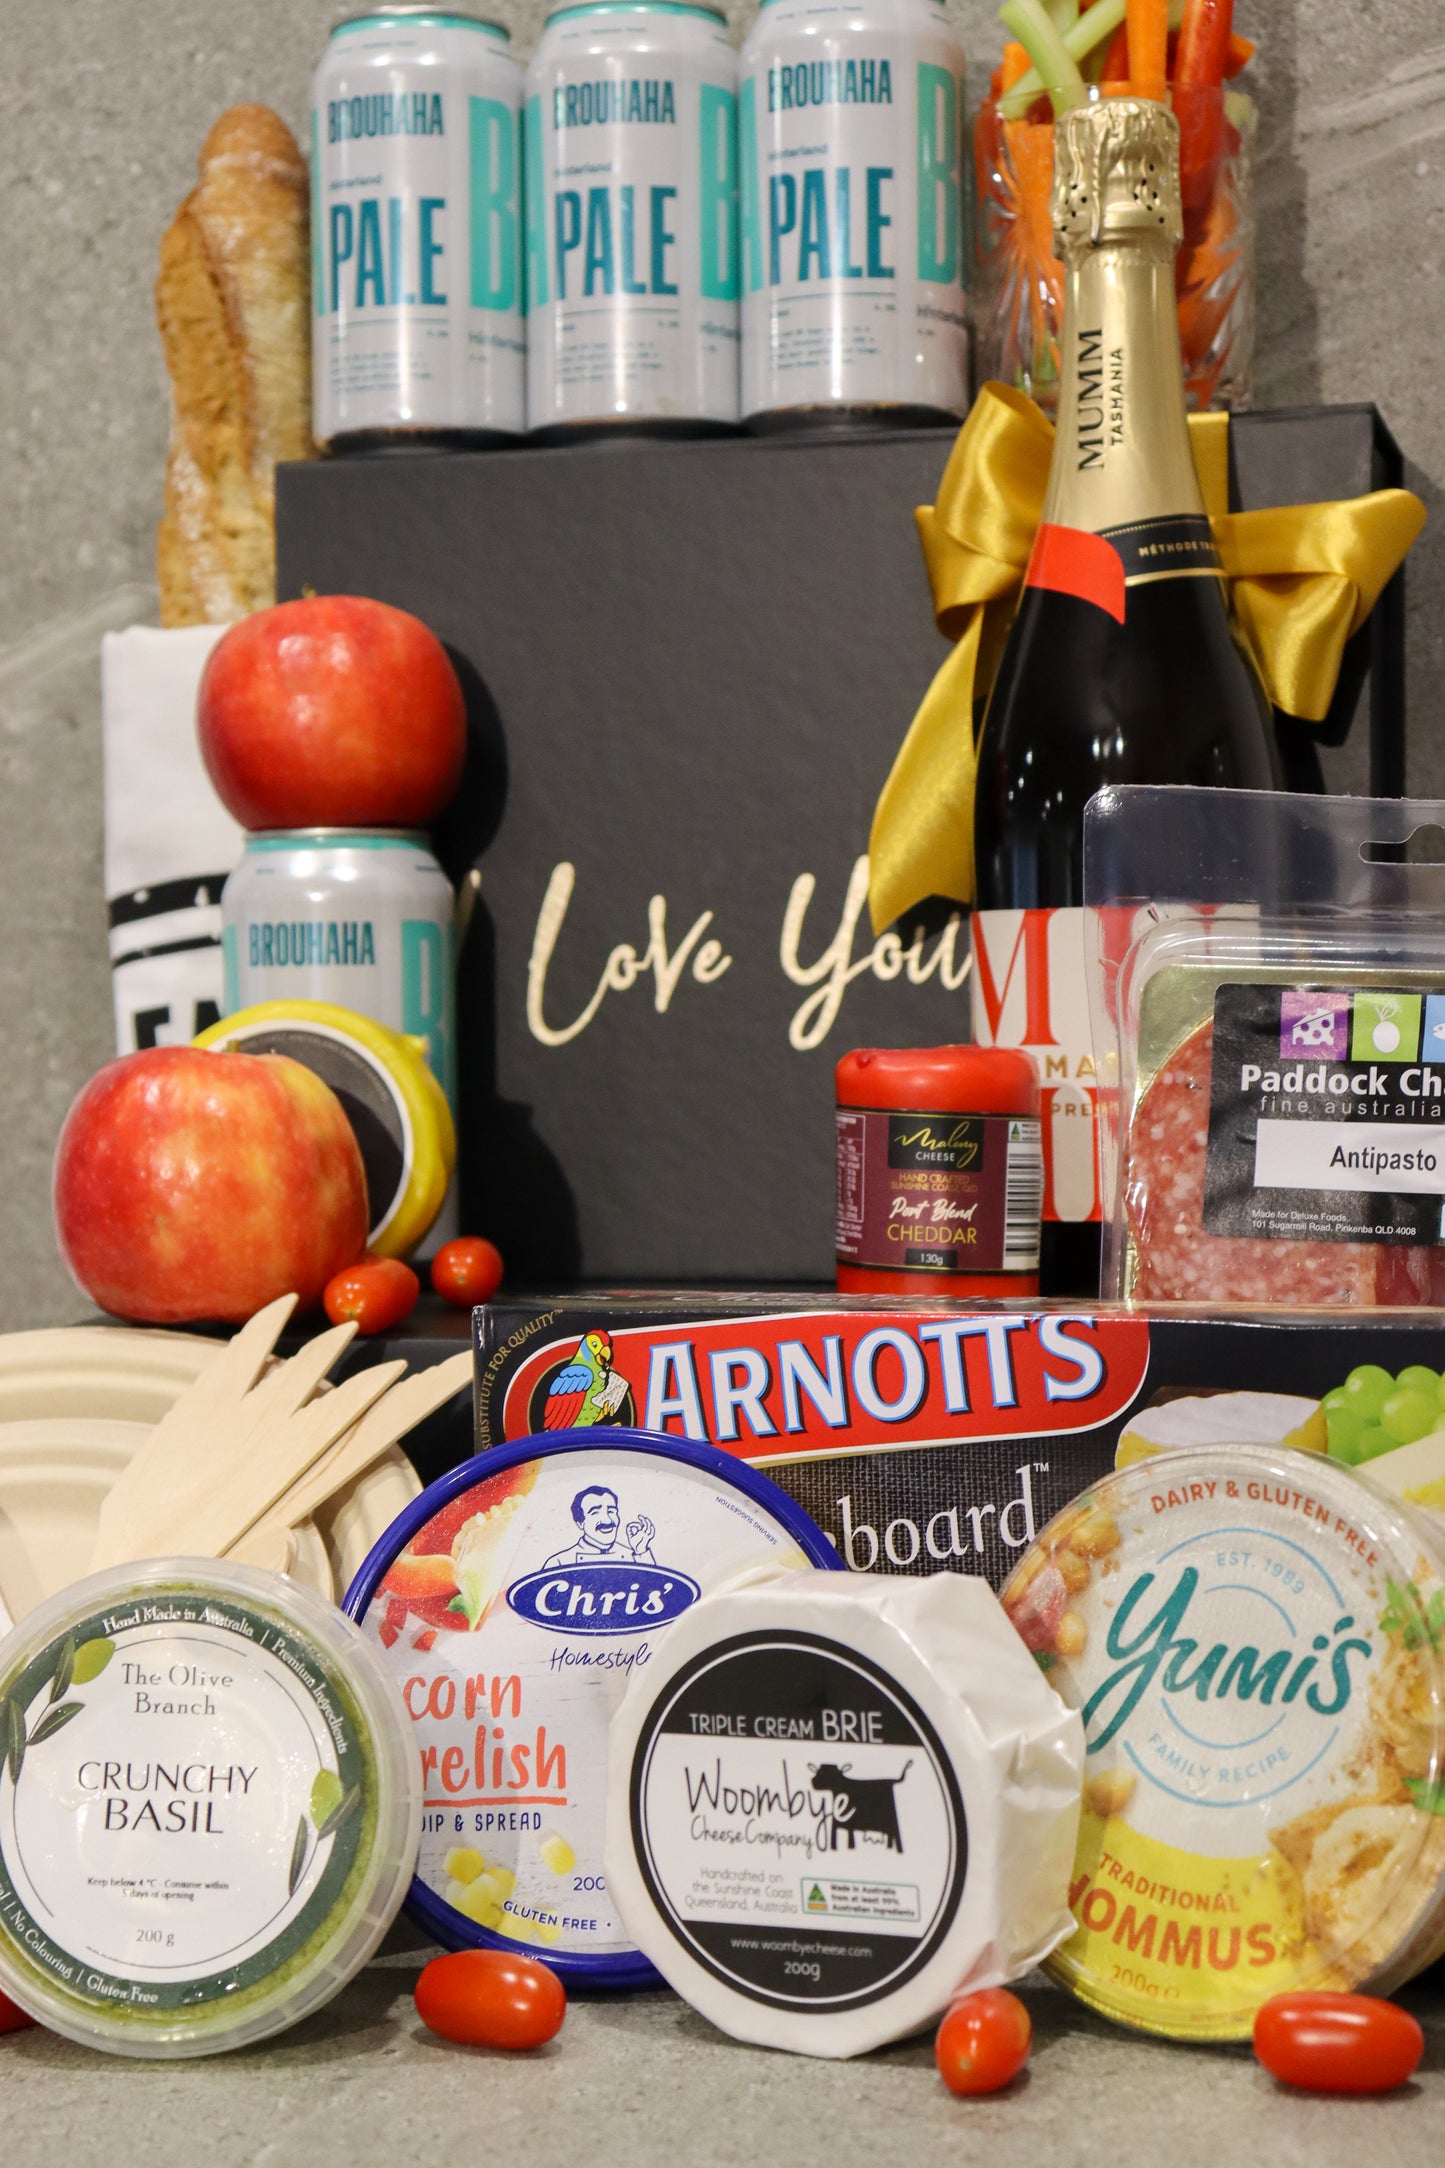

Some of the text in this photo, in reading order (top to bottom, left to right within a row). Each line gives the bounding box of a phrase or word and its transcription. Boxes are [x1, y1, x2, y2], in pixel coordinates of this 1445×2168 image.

[768, 59, 893, 113] BROUHAHA
[329, 92, 444, 144] BROUHAHA
[554, 79, 676, 130] BROUHAHA
[555, 185, 678, 300] PALE
[769, 166, 895, 286] PALE
[330, 197, 448, 313] PALE
[1078, 328, 1104, 471] MUMM
[1110, 348, 1123, 447] TASMANIA
[1138, 540, 1198, 558] MÉTHODE
[249, 920, 376, 967] BROUHAHA
[527, 861, 733, 1047] Love
[1241, 1064, 1445, 1098] Paddock Ch
[1260, 1096, 1309, 1114] fine
[915, 1151, 956, 1163] CHEESE
[1329, 1145, 1437, 1176] Antipasto
[899, 1172, 928, 1183] HAND
[888, 1196, 978, 1222] Port Blend
[1252, 1209, 1275, 1219] Made
[1277, 1210, 1289, 1219] for
[887, 1223, 977, 1245] CHEDDAR
[1252, 1220, 1266, 1229] 101
[1269, 1221, 1307, 1232] Sugarmill
[1336, 1224, 1373, 1234] Pinkenba
[1375, 1226, 1394, 1235] QLD
[1395, 1226, 1417, 1236] 4008
[920, 1252, 944, 1266] 130g
[488, 1346, 511, 1372] FOR
[645, 1312, 1104, 1443] ARNOTT'S
[482, 1370, 497, 1450] SUBSTITUTE
[715, 1495, 778, 1546] SERVING SUGGESTION
[1150, 1480, 1380, 1569] DAIRY & GLUTEN FREE
[1217, 1551, 1306, 1596] EST. 1989
[534, 1579, 674, 1618] Chris'
[101, 1604, 347, 1755] Hand Made in Australia Premium Ingredients
[122, 1663, 234, 1688] The Olive
[135, 1691, 216, 1716] Branch
[403, 1673, 522, 1722] corn
[689, 1708, 884, 1744] TRIPLE CREAM BRIE
[421, 1725, 567, 1793] relish
[1147, 1731, 1291, 1784] FAMILY RECIPE
[78, 1761, 259, 1794] CRUNCHY
[104, 1797, 224, 1834] BASIL
[454, 1812, 464, 1833] &
[475, 1811, 542, 1832] SPREAD
[684, 1757, 856, 1852] Woombye
[87, 1877, 108, 1888] Keep
[110, 1877, 137, 1887] below
[164, 1879, 203, 1889] Consume
[204, 1880, 230, 1889] within
[692, 1880, 710, 1893] the
[713, 1882, 761, 1897] Sunshine
[700, 1866, 784, 1884] Handcrafted on
[1100, 1852, 1243, 1914] TRADITIONAL
[129, 1888, 149, 1900] days
[161, 1891, 195, 1902] opening
[503, 1900, 598, 1931] GLUTEN FREE
[136, 1928, 163, 1943] 200
[730, 1938, 873, 1958] www.woombyecheese.com
[10, 1909, 159, 2004] No Colouring Gluten Free
[784, 1961, 821, 1982] 200g
